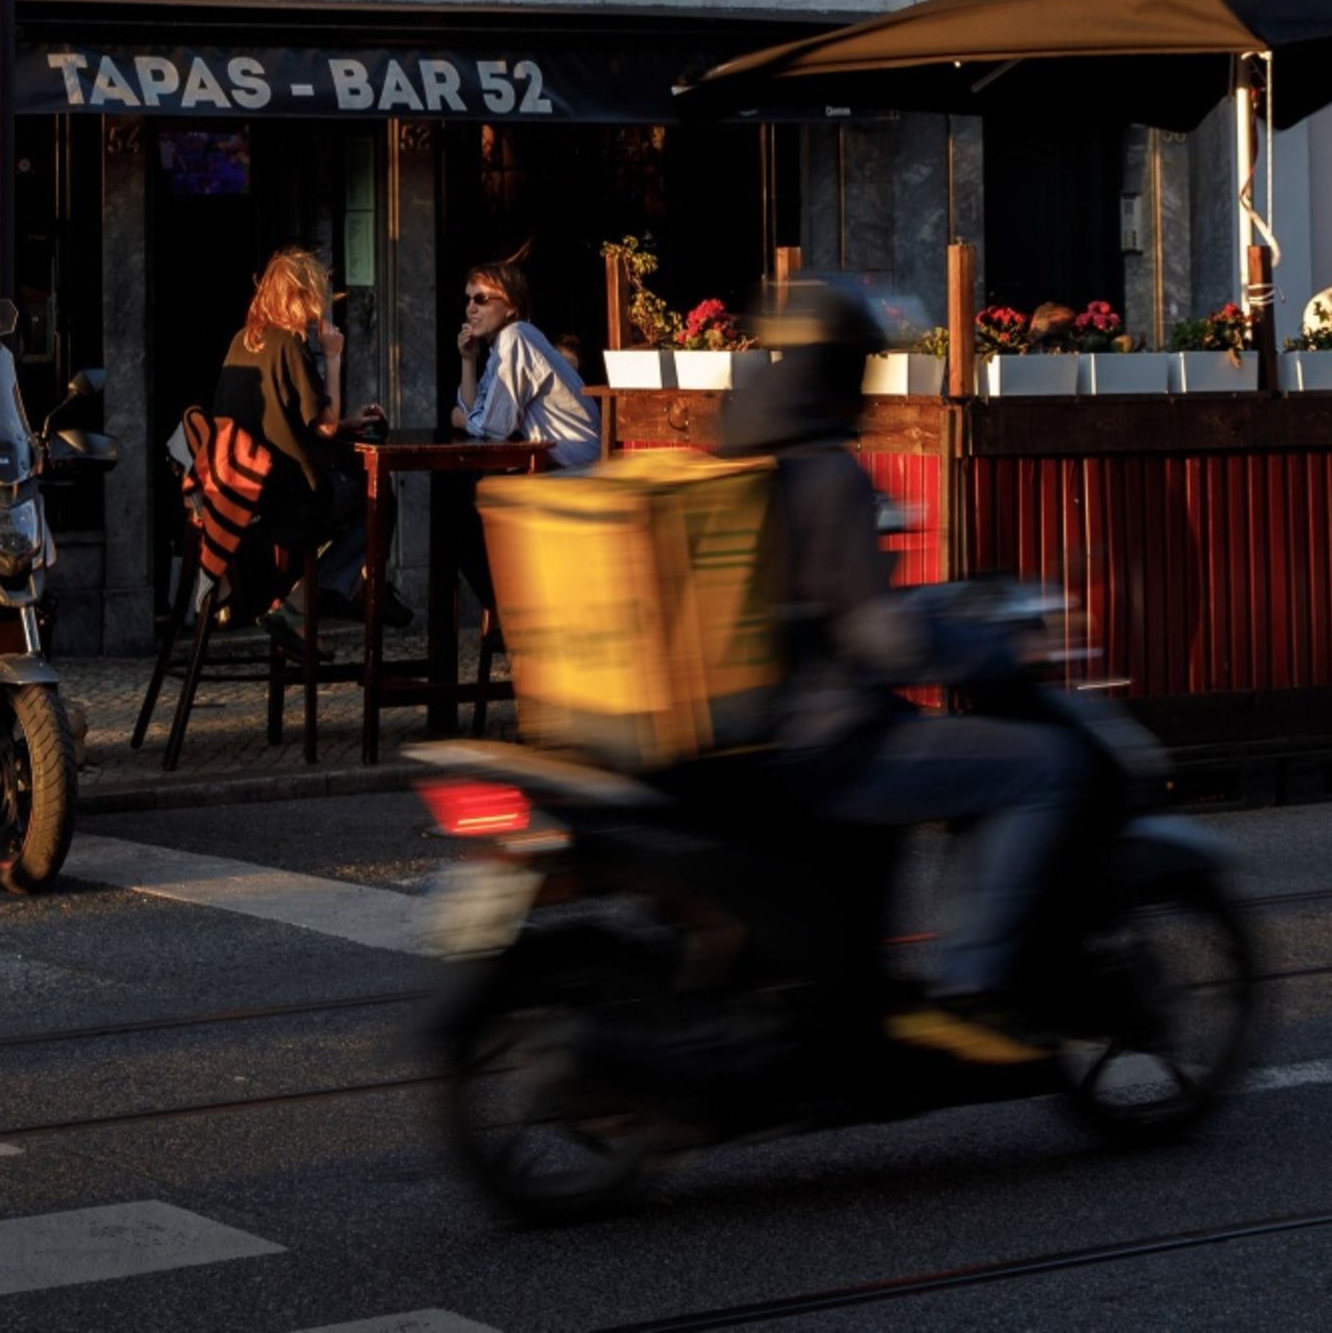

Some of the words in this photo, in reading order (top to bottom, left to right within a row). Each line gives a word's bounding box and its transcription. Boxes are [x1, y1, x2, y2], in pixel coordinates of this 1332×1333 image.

[47, 53, 272, 109] TAPAS
[328, 58, 467, 113] BAR
[475, 60, 553, 115] 52
[107, 124, 141, 154] 54
[399, 122, 431, 151] 52
